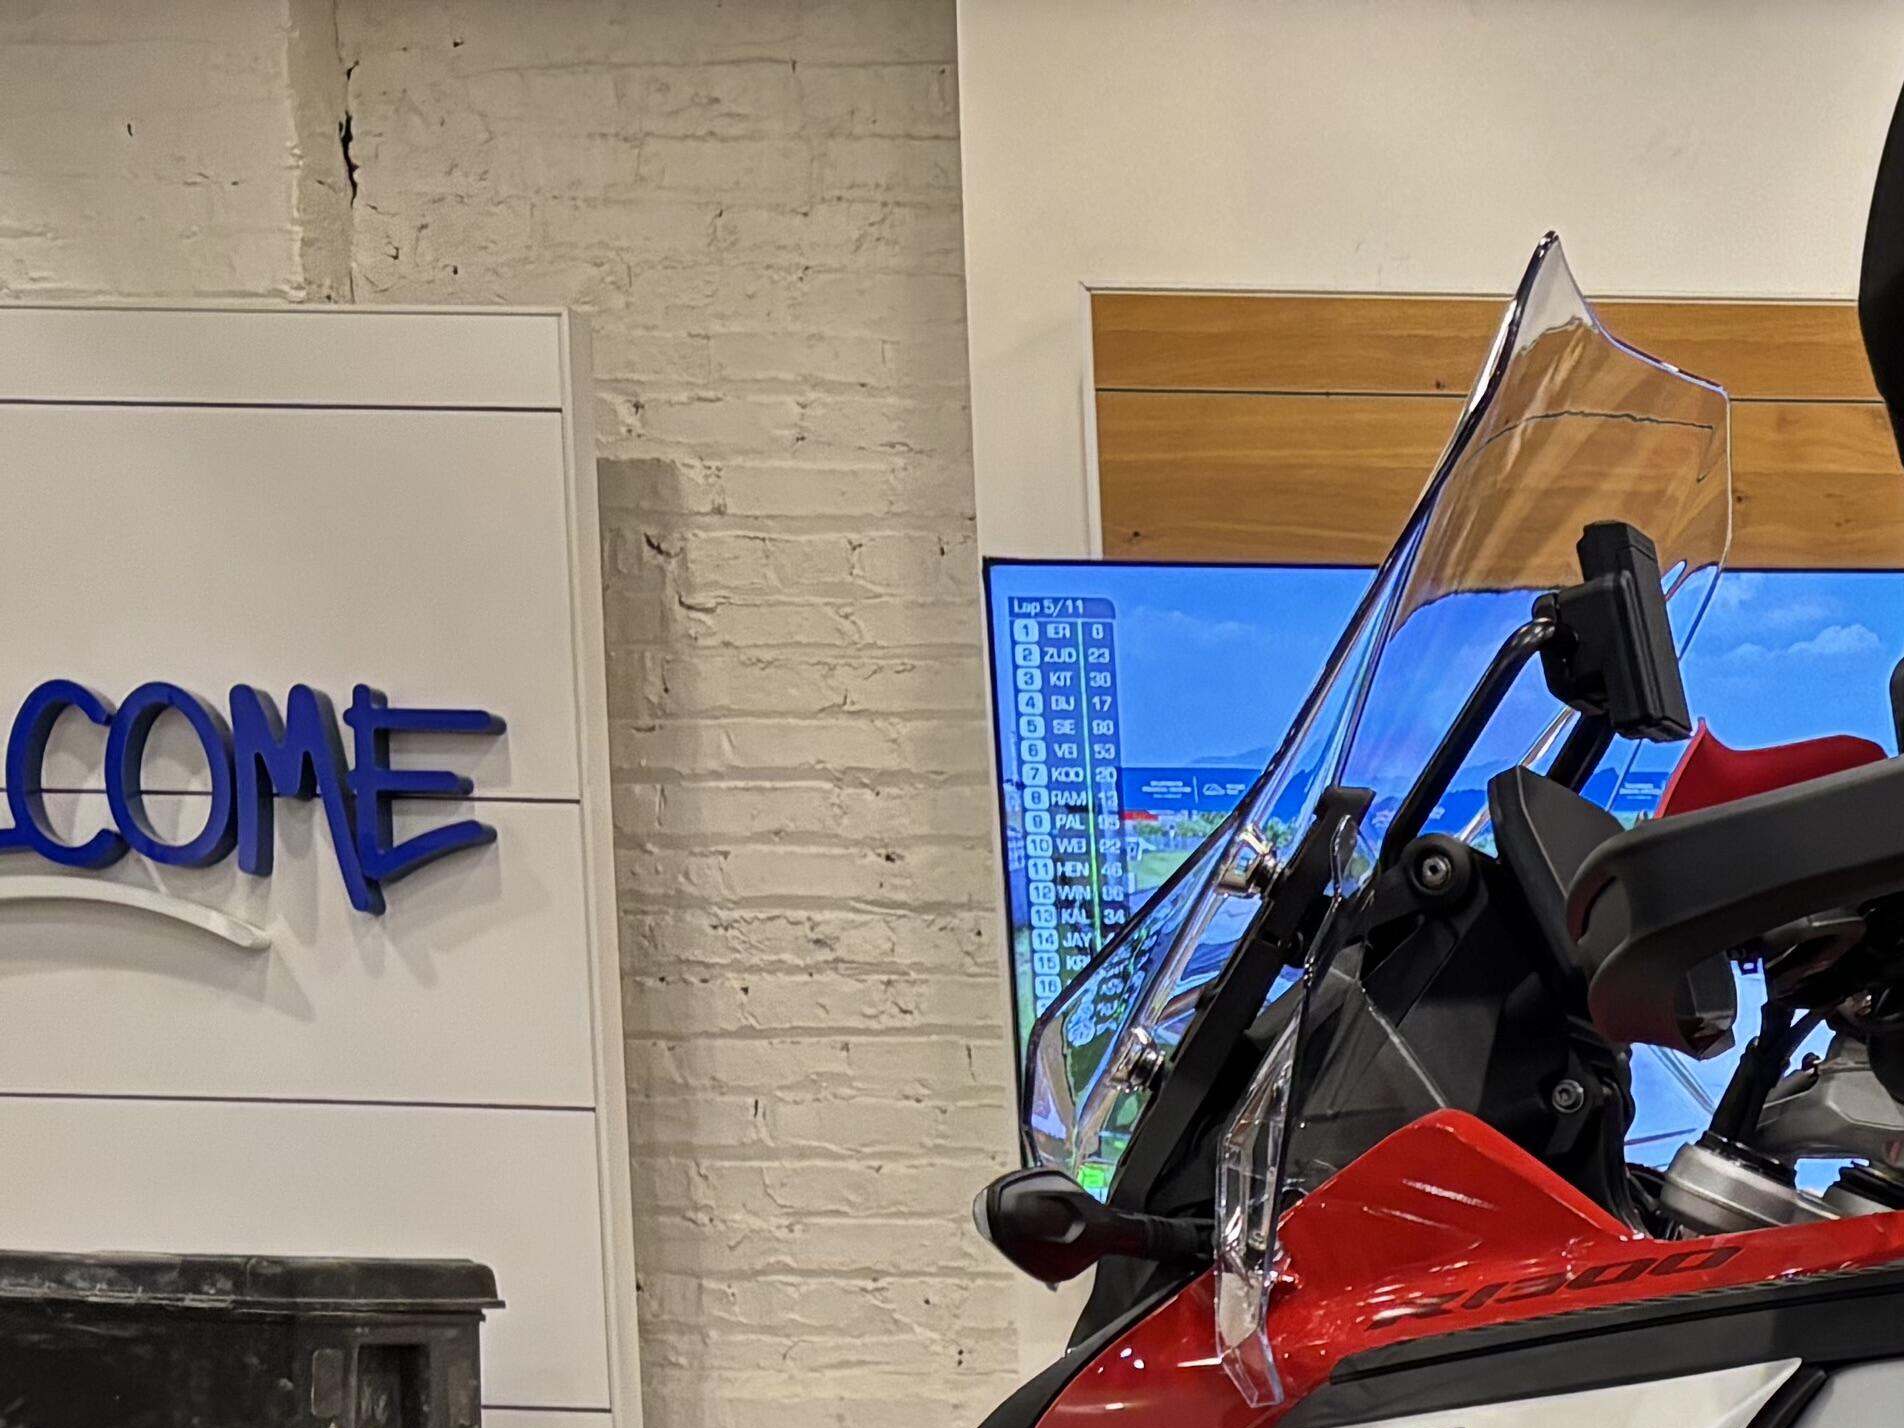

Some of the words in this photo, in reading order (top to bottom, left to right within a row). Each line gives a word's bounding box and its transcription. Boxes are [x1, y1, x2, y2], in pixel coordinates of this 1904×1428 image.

[1043, 599, 1084, 616] 5/11
[1088, 648, 1110, 663] 23
[1092, 696, 1112, 711] 17
[1095, 767, 1117, 783] 20
[0, 679, 508, 915] COME
[1055, 814, 1085, 830] PAL
[1104, 909, 1126, 924] 34
[1365, 1246, 1743, 1331] R1300
